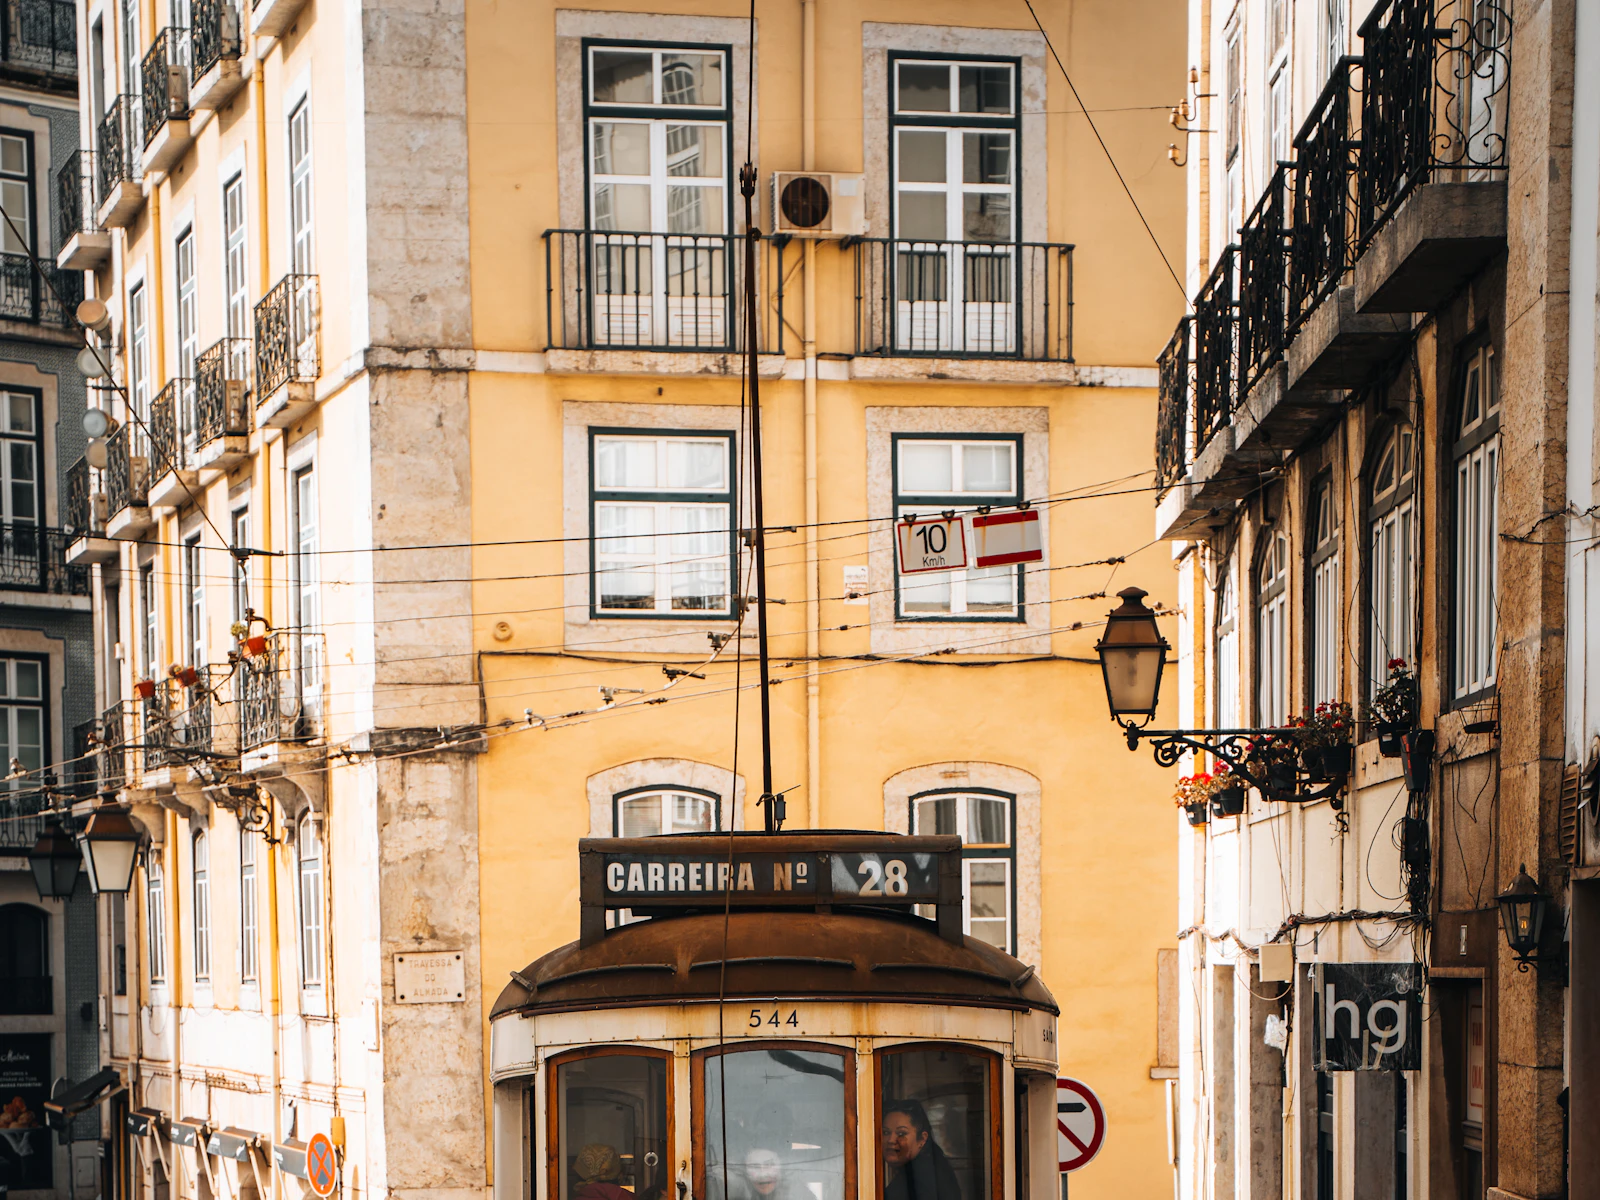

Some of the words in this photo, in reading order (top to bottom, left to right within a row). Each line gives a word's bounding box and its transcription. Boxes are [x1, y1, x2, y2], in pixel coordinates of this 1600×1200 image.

[916, 524, 947, 555] 10
[922, 555, 946, 568] Km/h
[606, 861, 756, 892] CARREIRA
[857, 859, 909, 898] 28
[408, 958, 453, 969] TRAVESSA
[424, 973, 436, 982] DO
[413, 987, 449, 997] ALMADA
[748, 1008, 799, 1029] 544
[1325, 983, 1407, 1054] hg
